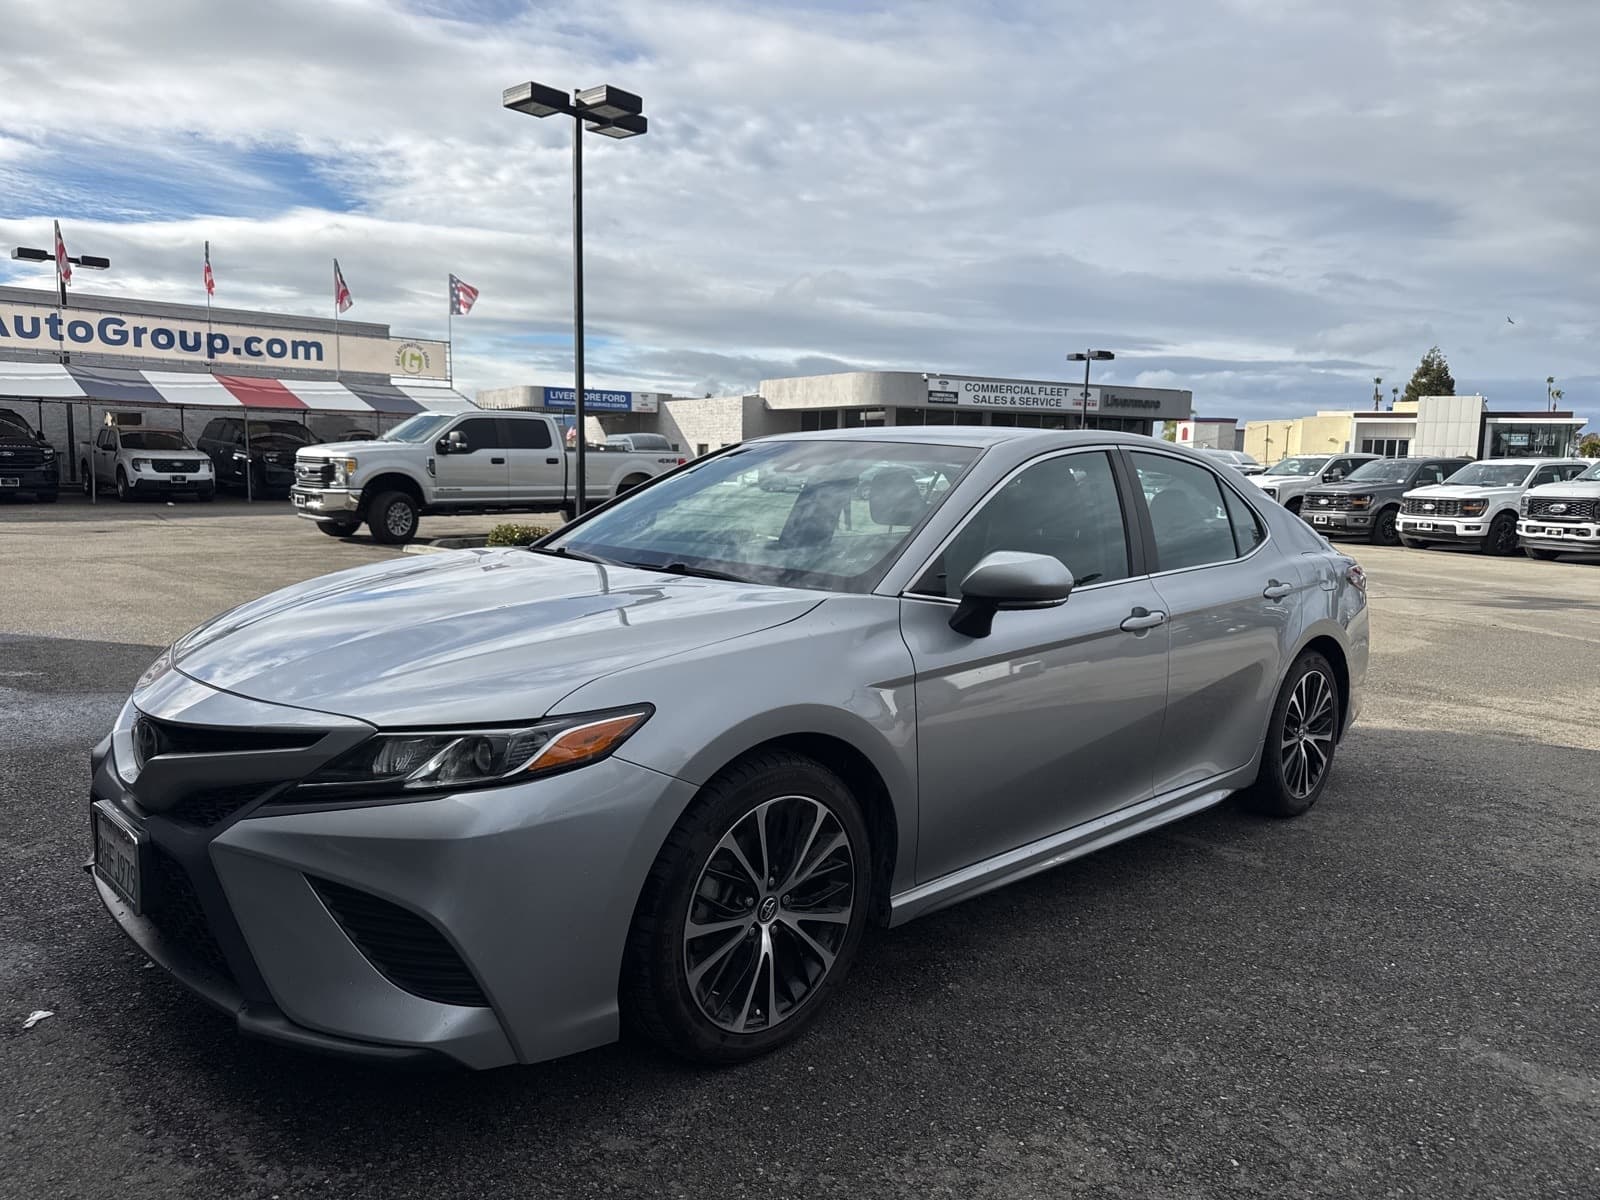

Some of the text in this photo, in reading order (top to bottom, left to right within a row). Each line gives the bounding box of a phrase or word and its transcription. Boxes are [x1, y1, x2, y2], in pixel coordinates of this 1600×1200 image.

[0, 312, 323, 361] utoGroup.com
[964, 382, 1036, 396] COMMERCIAL
[1038, 387, 1069, 397] FLEET
[550, 391, 601, 402] LIVERORE
[602, 394, 626, 403] FORD
[973, 394, 1009, 405] SALES
[1010, 396, 1017, 406] &
[1018, 397, 1062, 407] SERVICE
